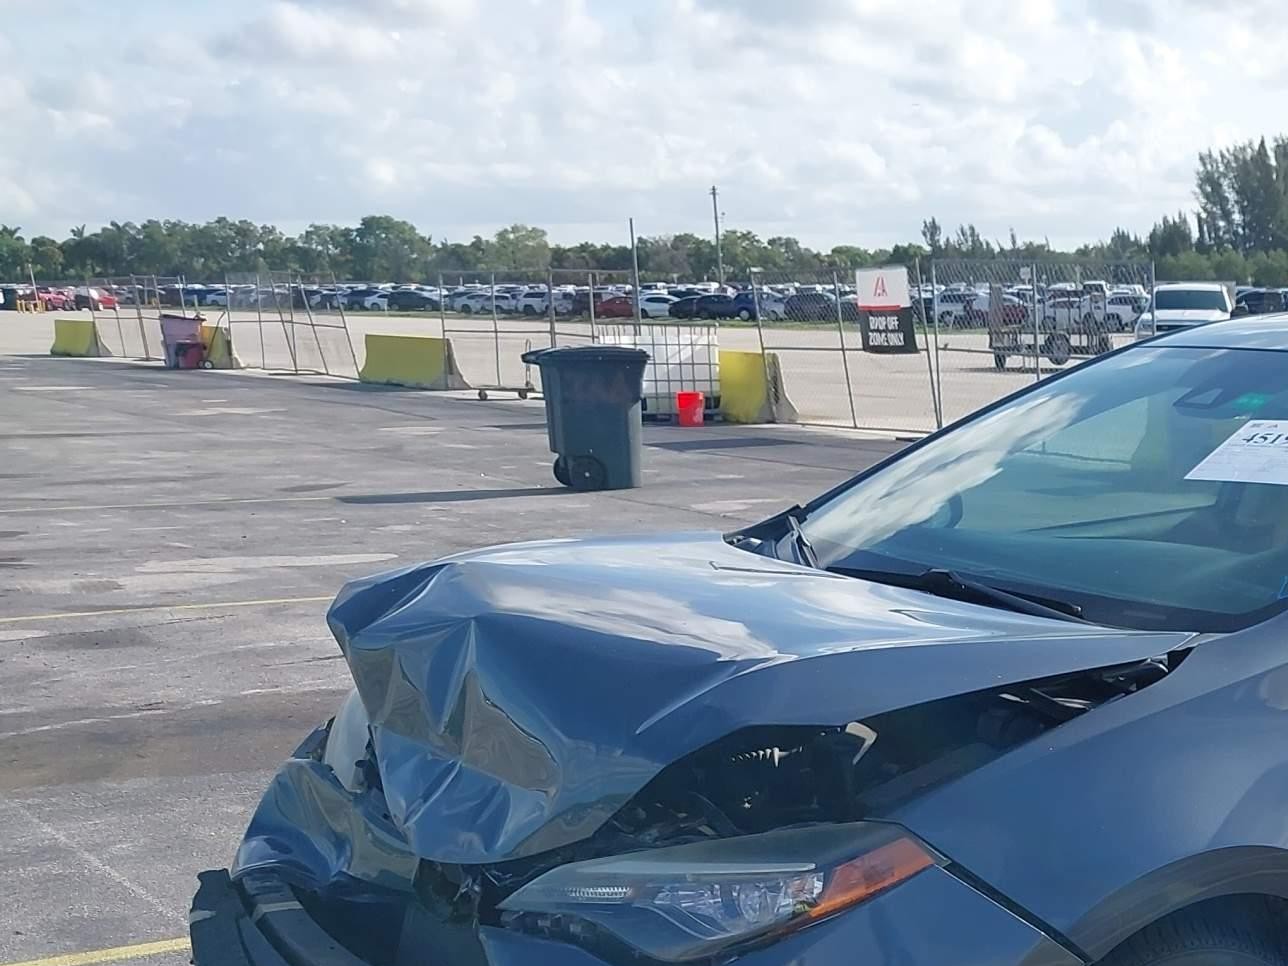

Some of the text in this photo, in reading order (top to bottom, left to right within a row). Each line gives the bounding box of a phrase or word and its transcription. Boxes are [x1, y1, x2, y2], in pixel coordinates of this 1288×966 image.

[887, 316, 899, 330] OFF
[868, 332, 904, 346] ZONE ONLY
